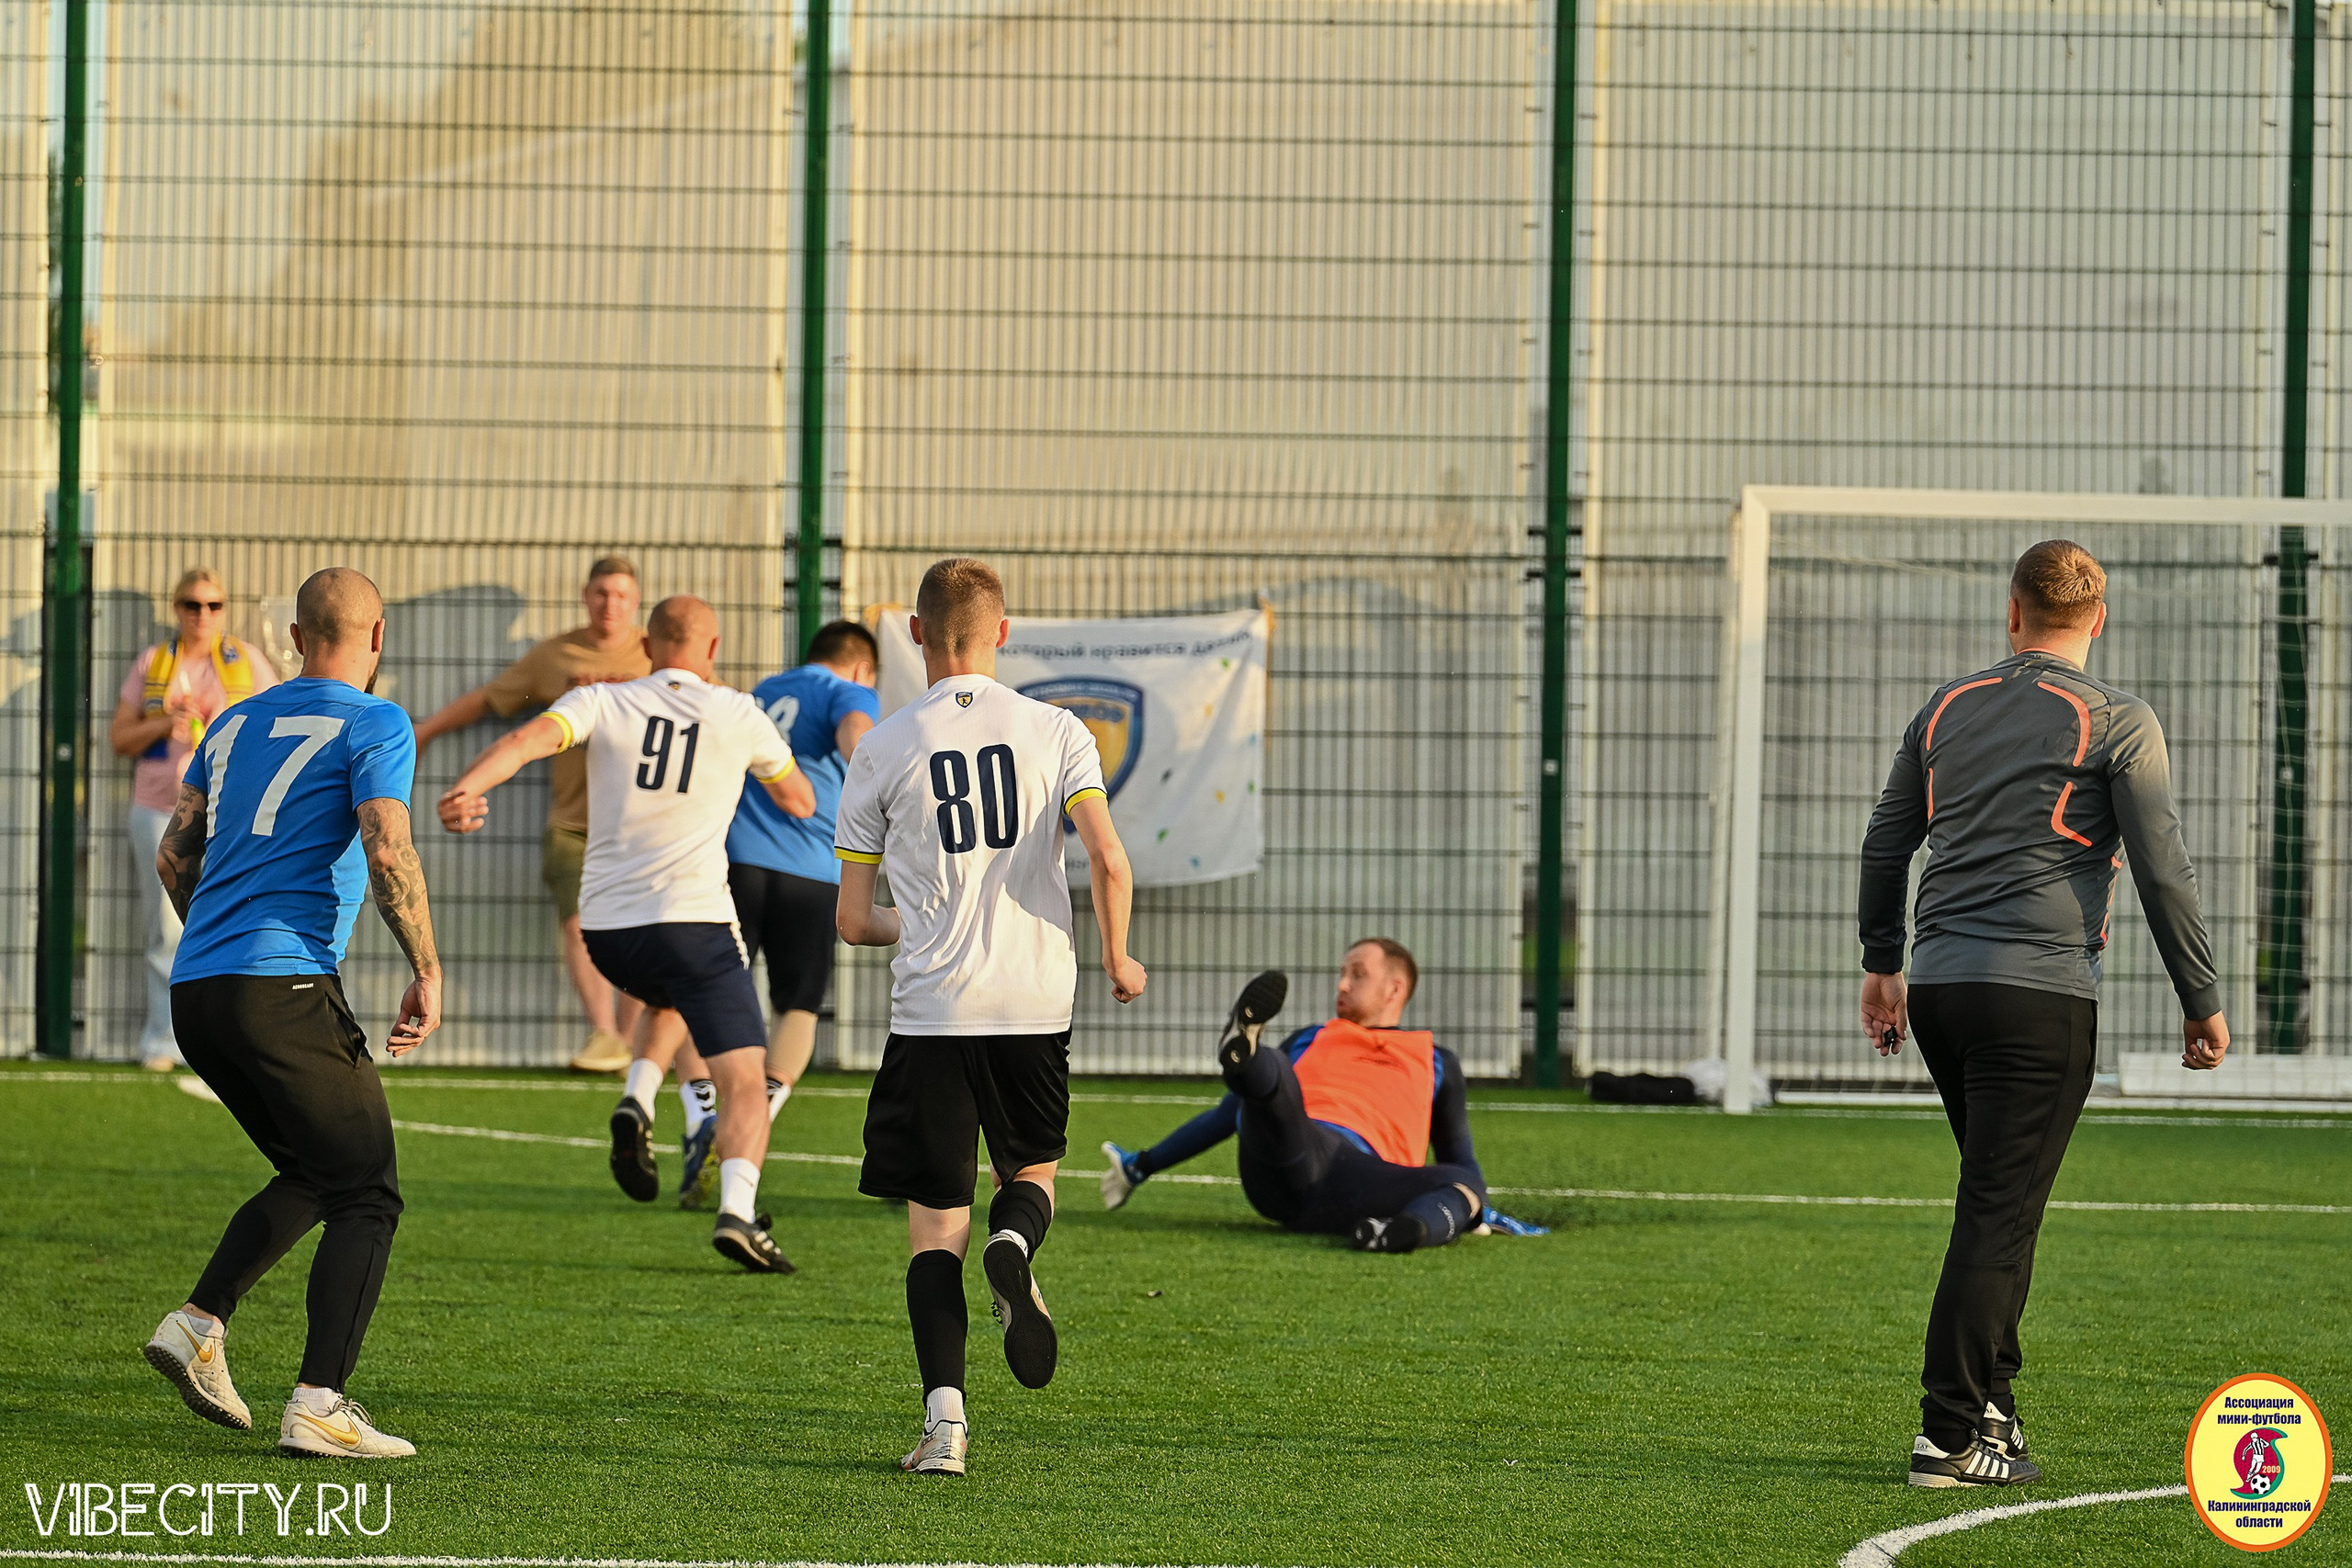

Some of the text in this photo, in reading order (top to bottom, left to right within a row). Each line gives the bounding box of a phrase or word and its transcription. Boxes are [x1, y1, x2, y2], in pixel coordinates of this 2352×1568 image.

[203, 715, 345, 838] 17
[636, 716, 700, 794] 91
[929, 743, 1019, 854] 80
